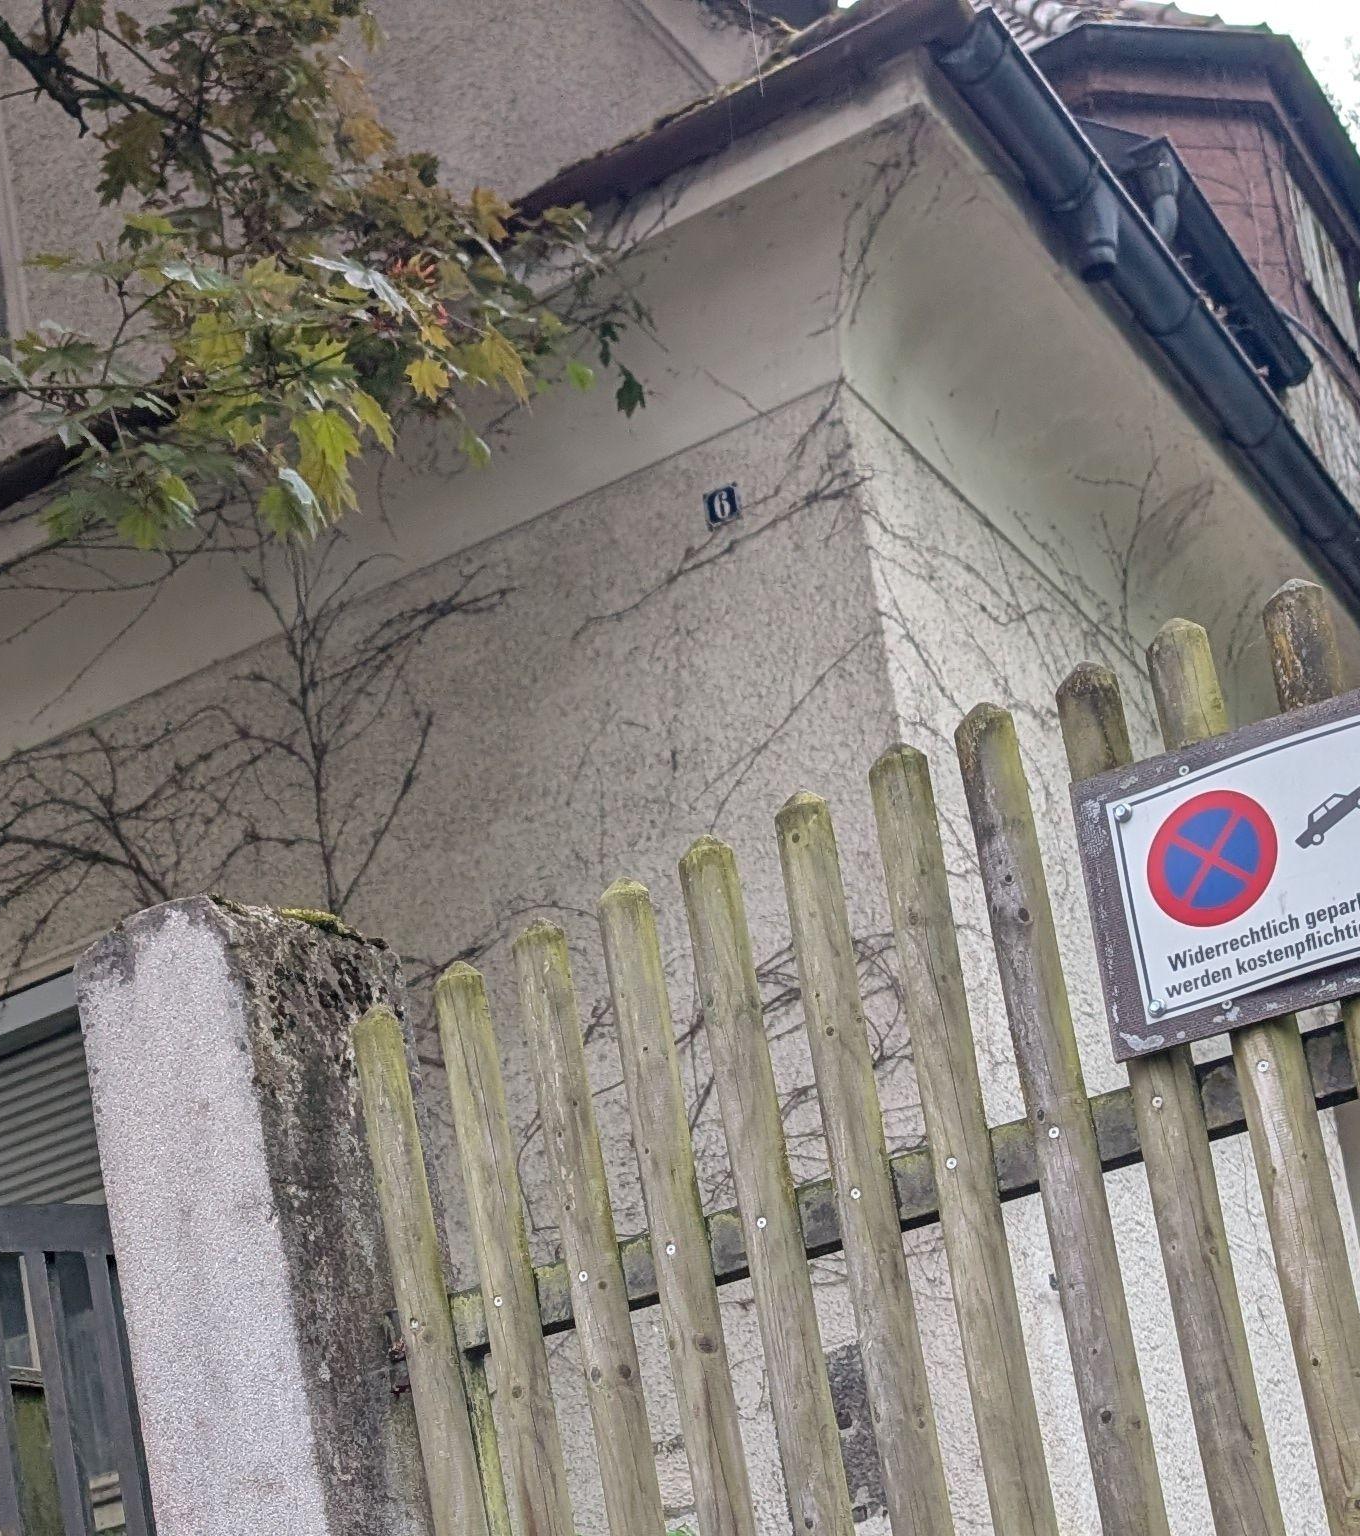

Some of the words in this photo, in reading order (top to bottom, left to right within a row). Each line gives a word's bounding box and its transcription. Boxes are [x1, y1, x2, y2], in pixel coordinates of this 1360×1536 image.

[713, 490, 731, 519] 6
[1167, 913, 1301, 972] Widerrechtlich
[1165, 966, 1233, 999] werden
